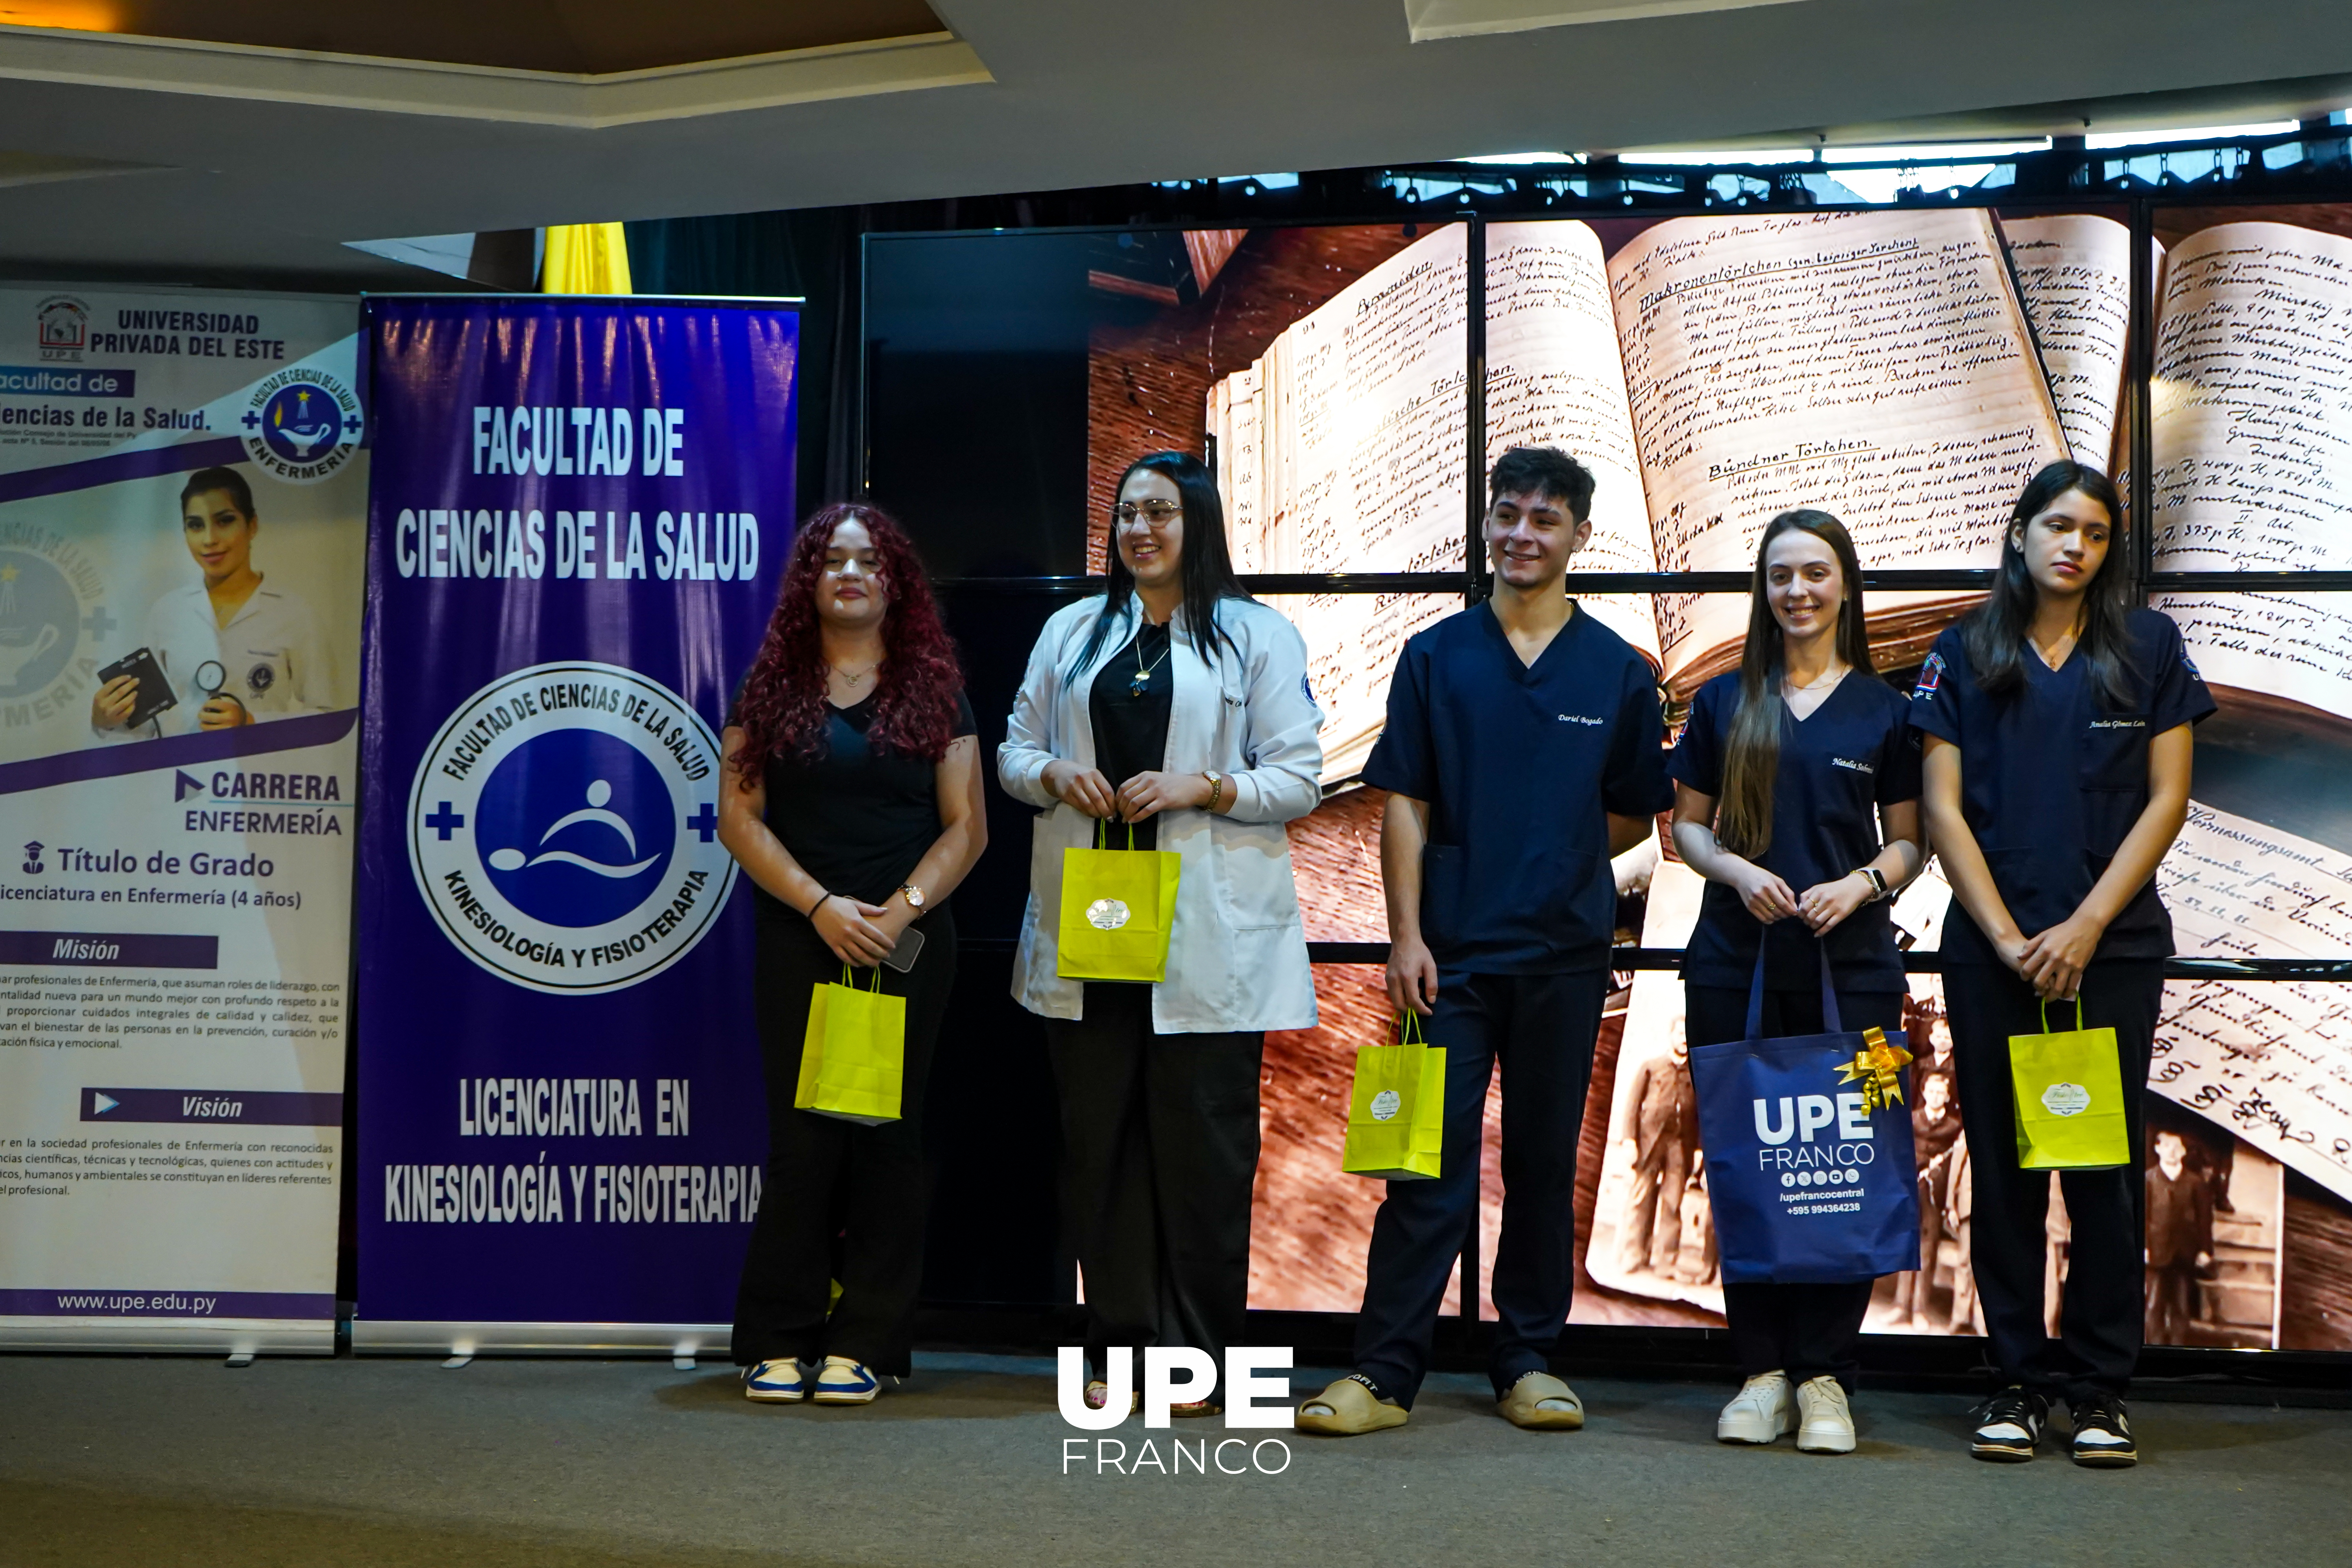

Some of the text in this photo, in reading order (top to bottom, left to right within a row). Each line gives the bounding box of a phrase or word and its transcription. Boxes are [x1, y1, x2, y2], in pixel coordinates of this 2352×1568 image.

[118, 310, 258, 333] UNIVERSIDAD
[90, 332, 285, 360] PRIVADA DEL ESTE
[0, 371, 118, 393] acultad de
[0, 404, 211, 430] encias de la Salud.
[473, 405, 684, 476] FACULTAD DE
[396, 508, 759, 582] CIENCIAS DE LA SALUD
[443, 683, 711, 782] FACULTAD DE CIENCIAS DE LA SALUD
[212, 771, 340, 801] CARRERA
[186, 808, 342, 836] ENFERMERÍA
[57, 847, 274, 877] Título de Grado
[101, 890, 122, 902] en
[128, 887, 225, 905] Enfermería
[231, 890, 248, 909] (4
[253, 891, 301, 911] años)
[444, 870, 709, 968] KINESIOLOGÍA Y FISIOTERAPIA
[52, 938, 120, 961] Misión
[13, 974, 82, 986] profesionales
[84, 976, 98, 986] de
[99, 976, 160, 988] Enfermería,
[162, 980, 182, 989] que
[184, 980, 225, 988] asuman
[227, 980, 253, 990] roles
[254, 981, 268, 990] de
[270, 981, 320, 994] liderazgo,
[44, 993, 77, 1001] nueva
[81, 994, 104, 1003] para
[125, 993, 163, 1003] mundo
[166, 995, 198, 1005] mejor
[224, 995, 273, 1006] profundo
[277, 998, 317, 1008] respeto
[330, 998, 339, 1007] la
[7, 1007, 338, 1024] proporcionar cuidados integrales de calidad y calidez, que
[21, 1021, 30, 1031] el
[34, 1021, 84, 1032] bienestar
[88, 1023, 101, 1032] de
[105, 1023, 119, 1033] las
[124, 1025, 171, 1035] personas
[193, 1025, 203, 1035] la
[207, 1027, 268, 1038] prevención,
[272, 1028, 317, 1038] curación
[321, 1028, 338, 1040] y/o
[29, 1036, 55, 1047] física
[57, 1040, 63, 1049] y
[65, 1039, 122, 1049] emocional.
[183, 1096, 242, 1117] Visión
[460, 1077, 689, 1136] LICENCIATURA EN
[1753, 1093, 1874, 1145] UPE
[27, 1138, 36, 1147] la
[41, 1139, 87, 1149] sociedad
[91, 1139, 163, 1151] profesionales
[167, 1140, 180, 1150] de
[185, 1140, 243, 1151] Enfermería
[271, 1143, 334, 1154] reconocidas
[1759, 1143, 1874, 1171] FRANCO
[25, 1153, 80, 1165] científicas,
[83, 1154, 126, 1165] técnicas
[129, 1158, 136, 1167] y
[139, 1156, 207, 1168] tecnológicas,
[210, 1158, 251, 1168] quienes
[275, 1159, 324, 1169] actitudes
[327, 1162, 333, 1171] y
[24, 1169, 73, 1180] humanos
[75, 1173, 81, 1182] y
[83, 1170, 148, 1181] ambientales
[163, 1173, 225, 1184] constituyan
[242, 1173, 277, 1184] líderes
[278, 1173, 332, 1185] referentes
[385, 1151, 762, 1223] KINESIOLOGÍA Y FISIOTERAPIA
[8, 1184, 70, 1197] profesional.
[1780, 1188, 1864, 1203] /upefrancocentral
[1787, 1203, 1861, 1215] +595 994364238
[57, 1293, 216, 1315] www.upe.edu.py
